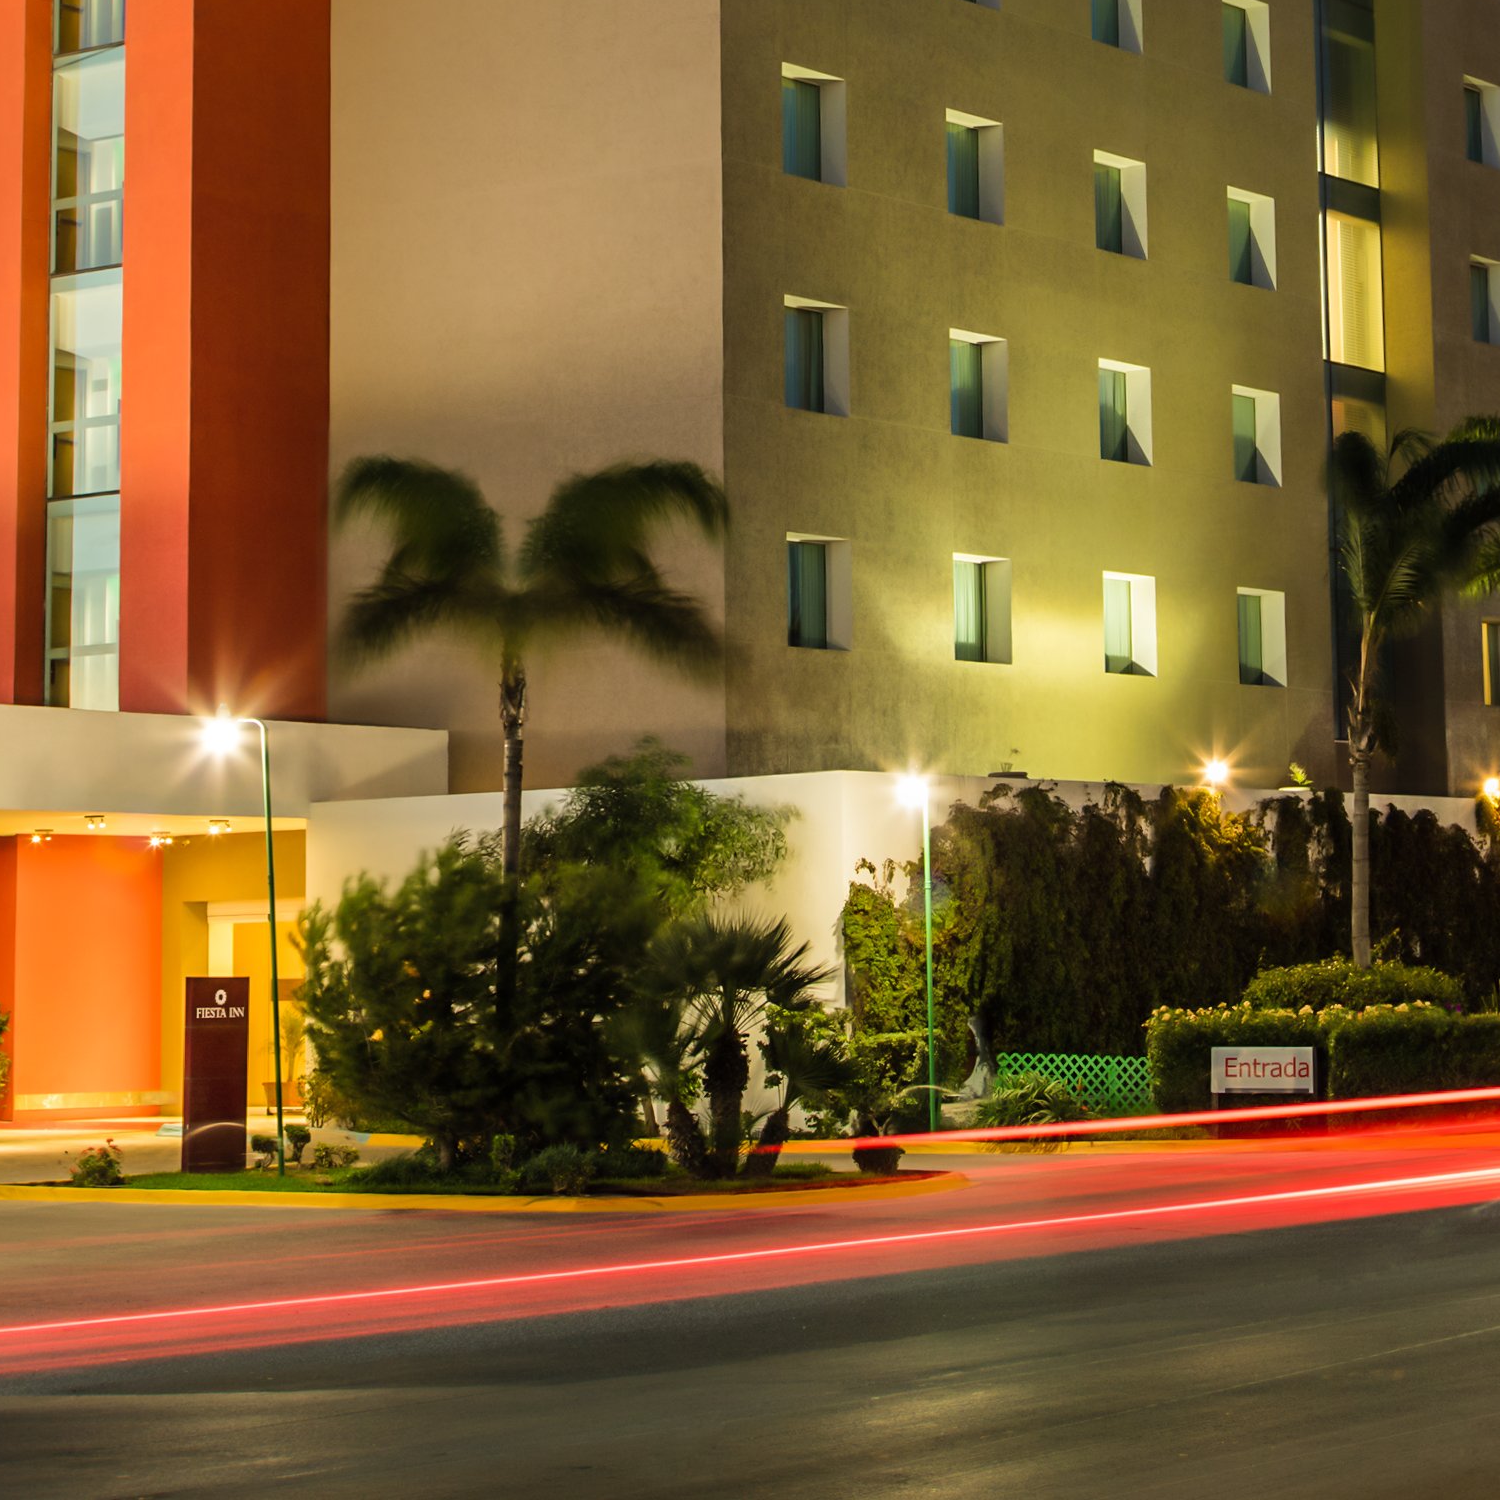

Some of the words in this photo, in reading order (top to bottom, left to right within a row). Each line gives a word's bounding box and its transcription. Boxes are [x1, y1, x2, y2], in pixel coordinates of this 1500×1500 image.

[196, 1007, 227, 1019] FIESTA
[229, 1006, 245, 1018] INN
[1224, 1056, 1310, 1078] Entrada
